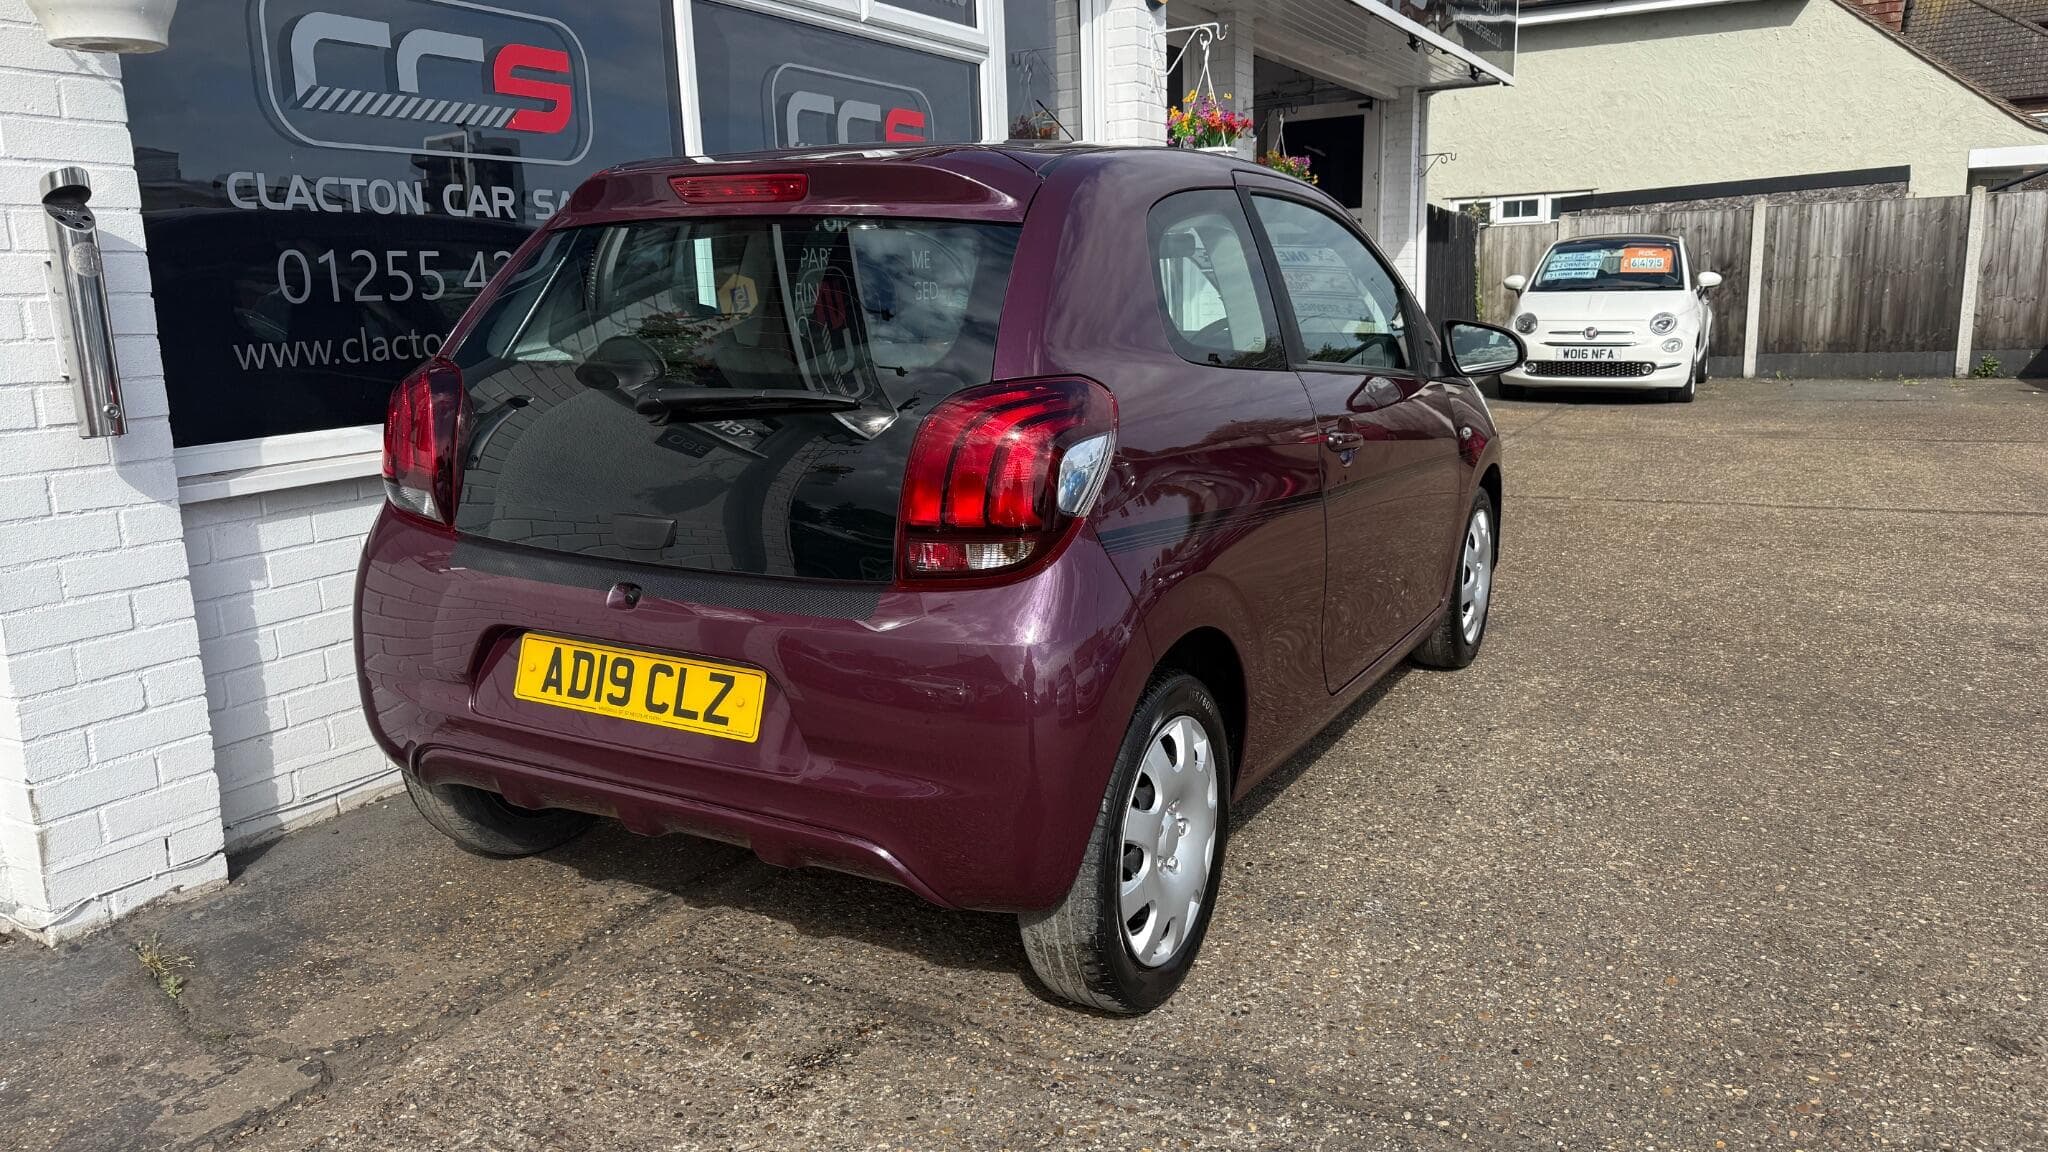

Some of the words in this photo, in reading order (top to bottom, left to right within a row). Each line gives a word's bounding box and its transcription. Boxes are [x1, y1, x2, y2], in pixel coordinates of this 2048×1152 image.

[291, 11, 572, 133] CCS
[226, 171, 425, 216] CLACTON
[443, 184, 517, 219] CAR
[277, 249, 446, 305] 01255
[233, 326, 448, 371] www.clacto
[1563, 348, 1588, 359] WO16
[1591, 348, 1614, 359] NFA
[541, 646, 635, 707] AD19
[645, 663, 735, 726] CLZ
